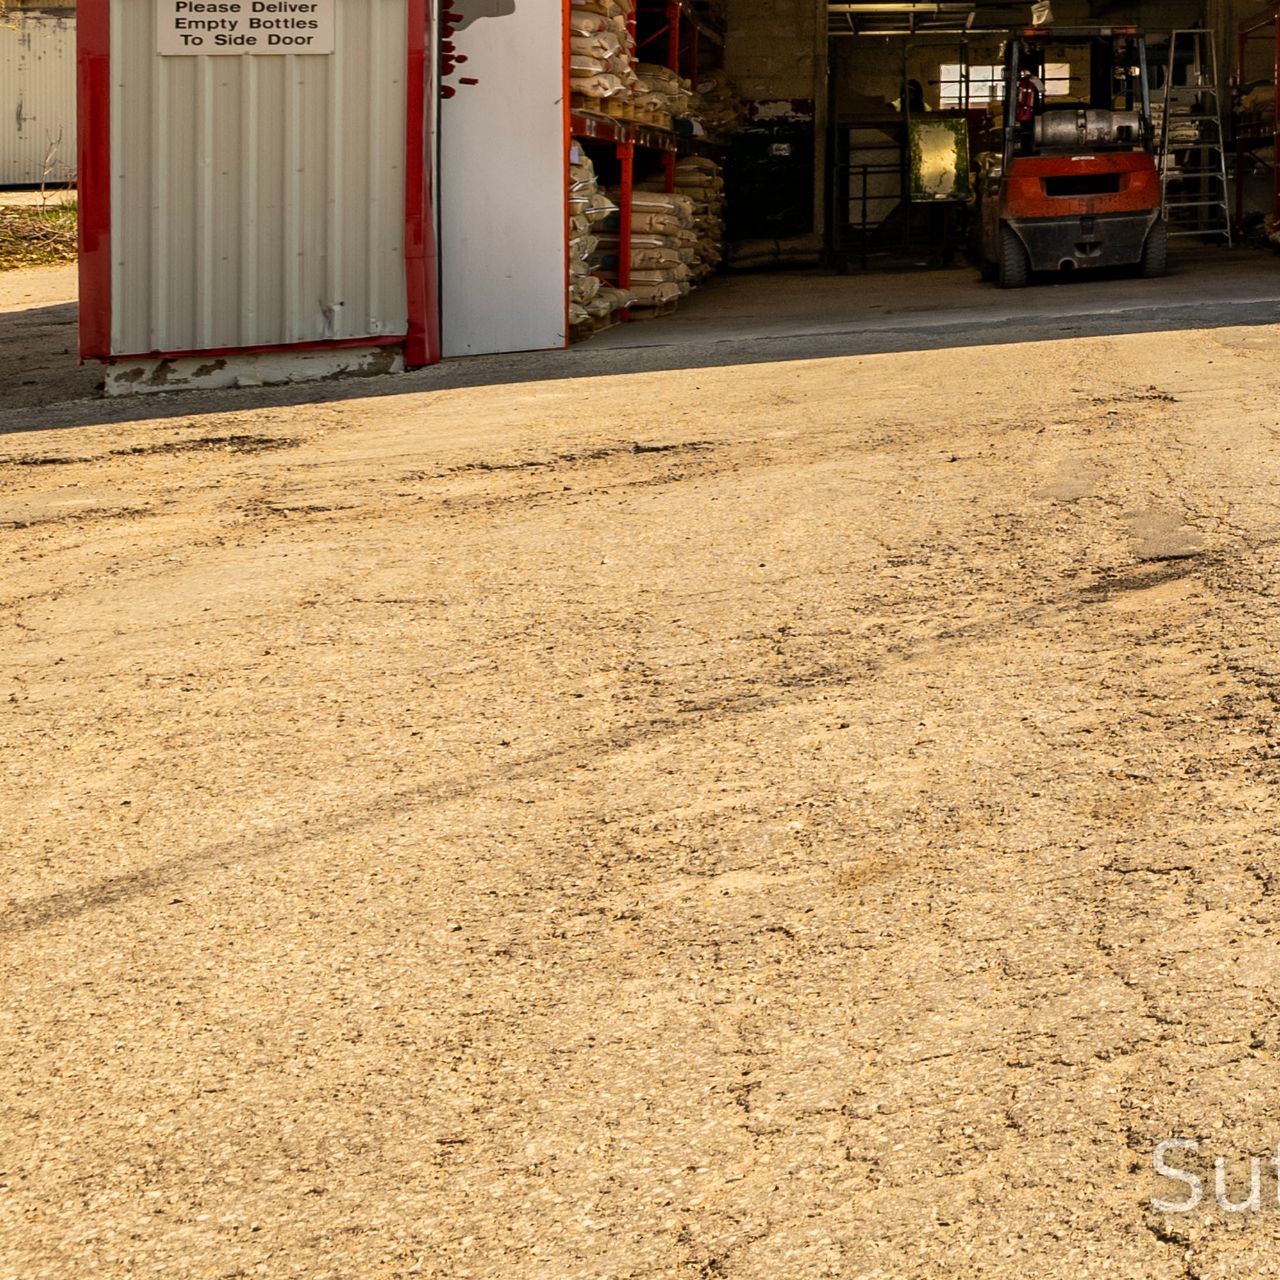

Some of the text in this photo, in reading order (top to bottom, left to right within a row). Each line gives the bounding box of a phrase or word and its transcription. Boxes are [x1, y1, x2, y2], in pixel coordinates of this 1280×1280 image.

[175, 1, 318, 14] Please Deliver
[175, 18, 319, 33] Empty Bottles
[180, 34, 314, 46] To Side Door
